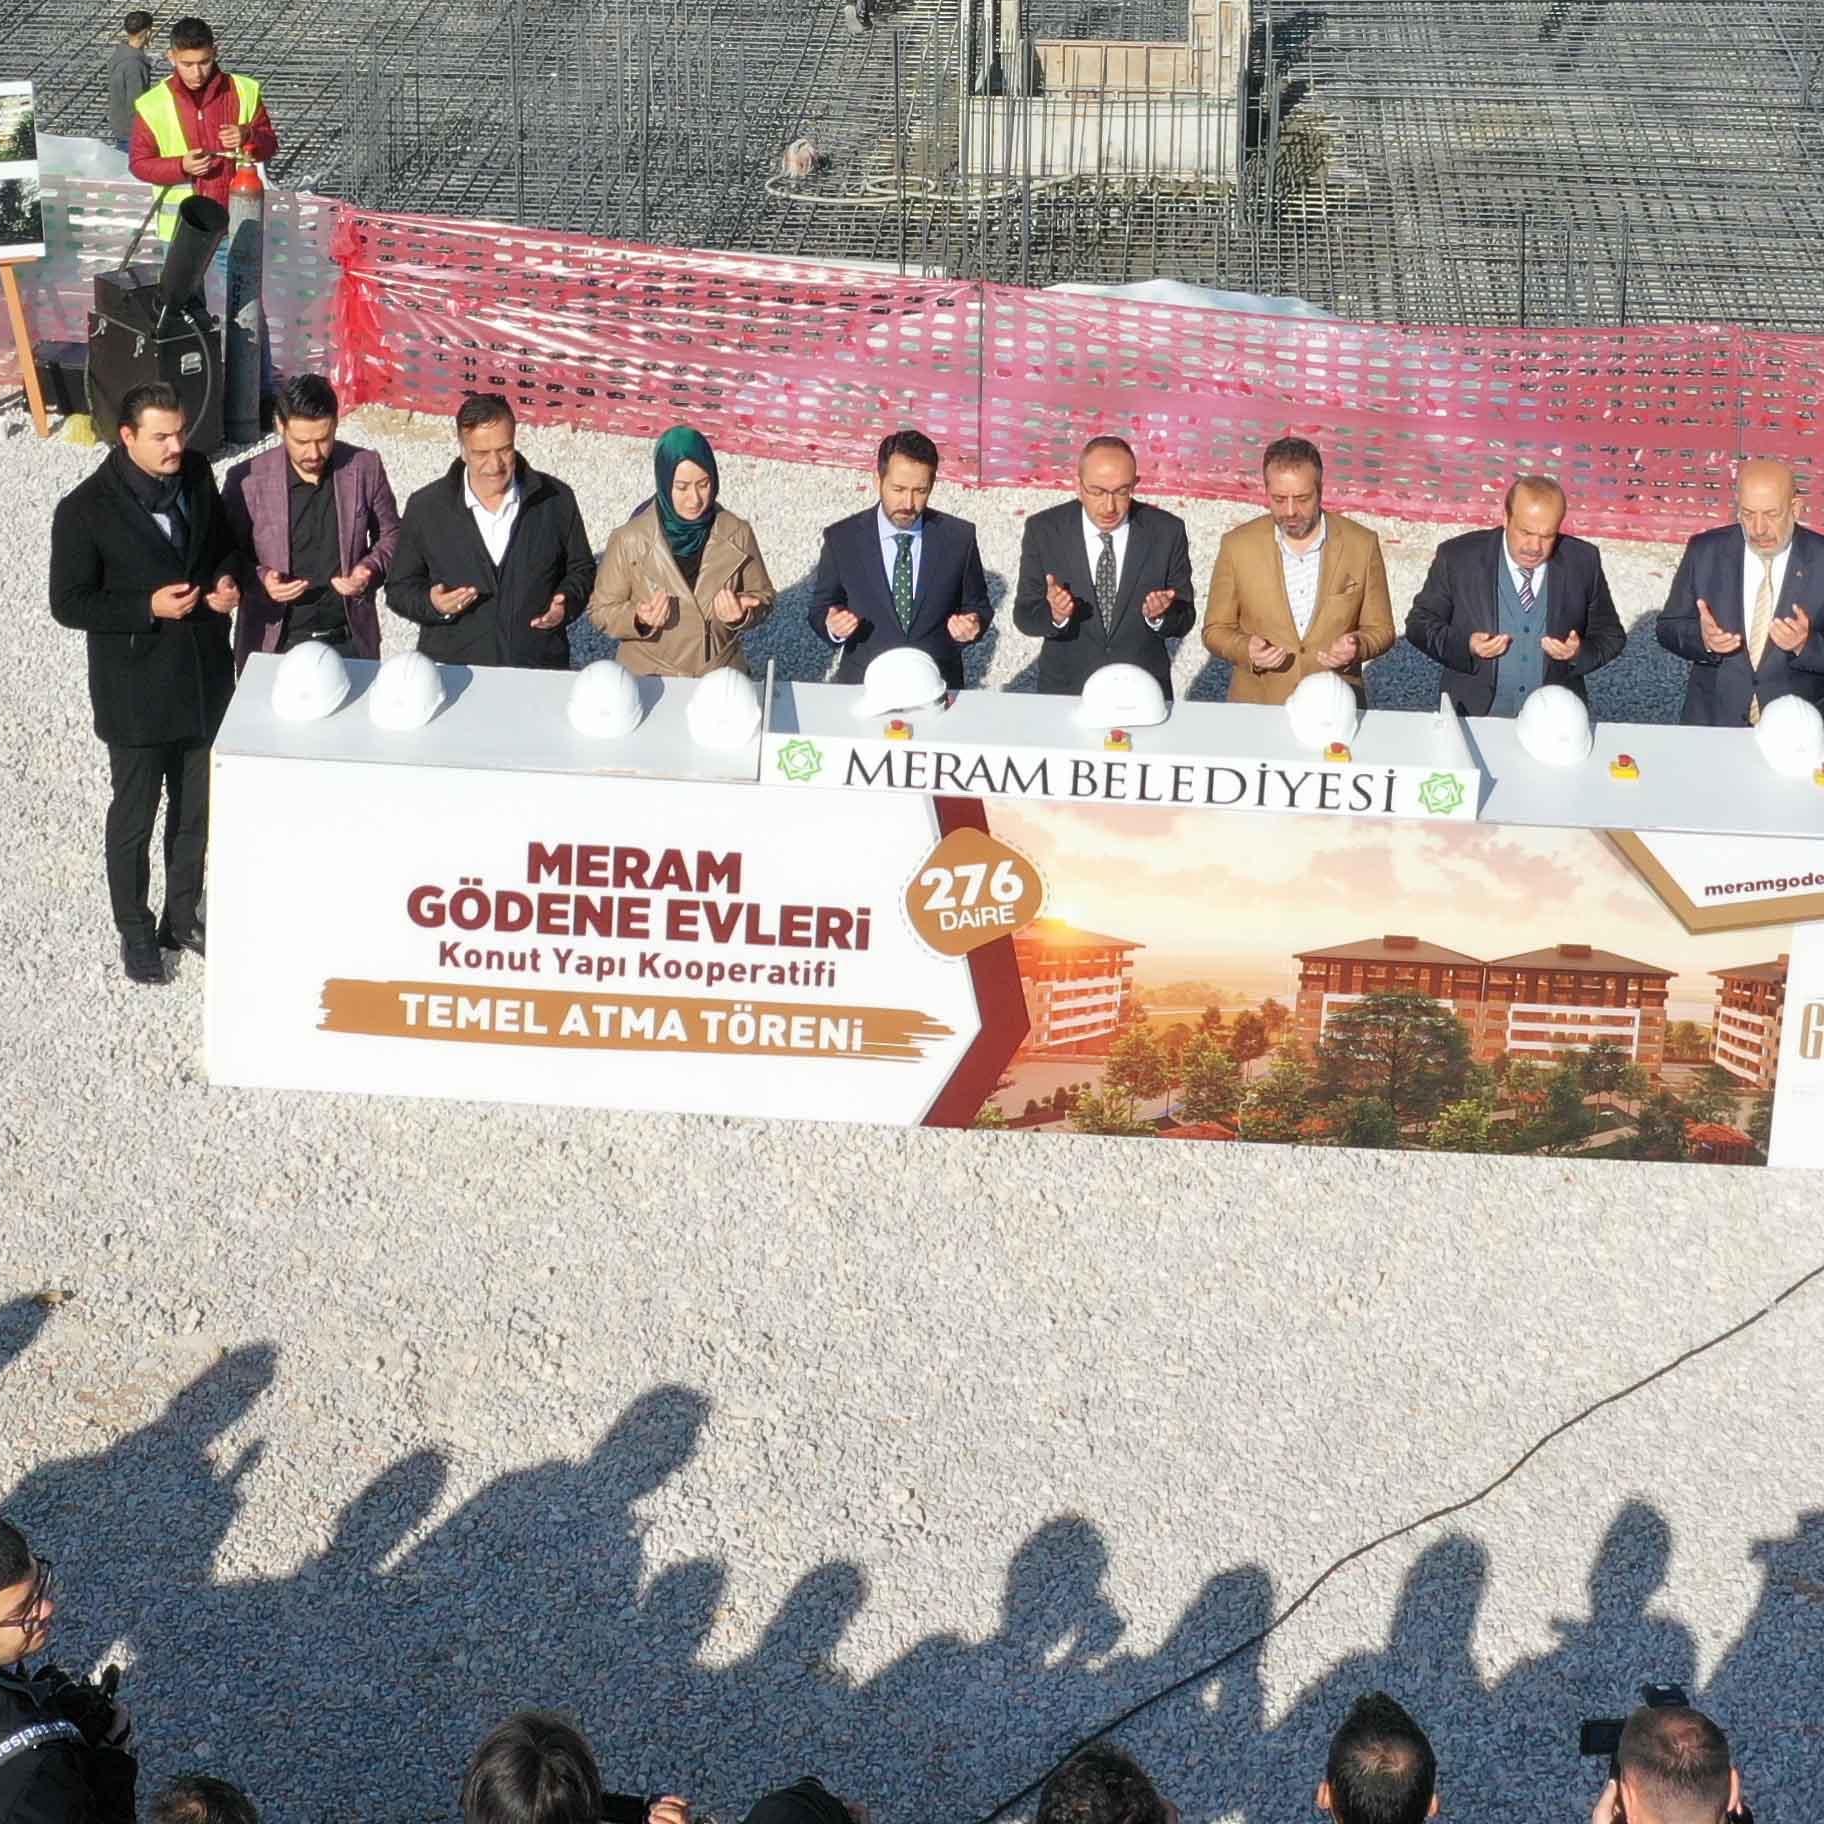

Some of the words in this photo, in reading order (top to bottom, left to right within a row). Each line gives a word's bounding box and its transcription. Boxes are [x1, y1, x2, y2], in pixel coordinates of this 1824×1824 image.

[844, 748, 1051, 795] MERAM
[1069, 758, 1397, 814] BELEDİYESİ
[527, 841, 742, 895] MERAM
[920, 861, 1024, 912] 276
[407, 878, 650, 939] GÖDENE
[666, 898, 871, 952] EVLERİ
[438, 941, 541, 973] Konut
[556, 949, 626, 981] Yapı
[638, 953, 837, 988] Kooperatifi
[398, 992, 548, 1035] TEMEL
[558, 1002, 687, 1043] ATMA
[700, 1003, 864, 1052] TÖRENİ
